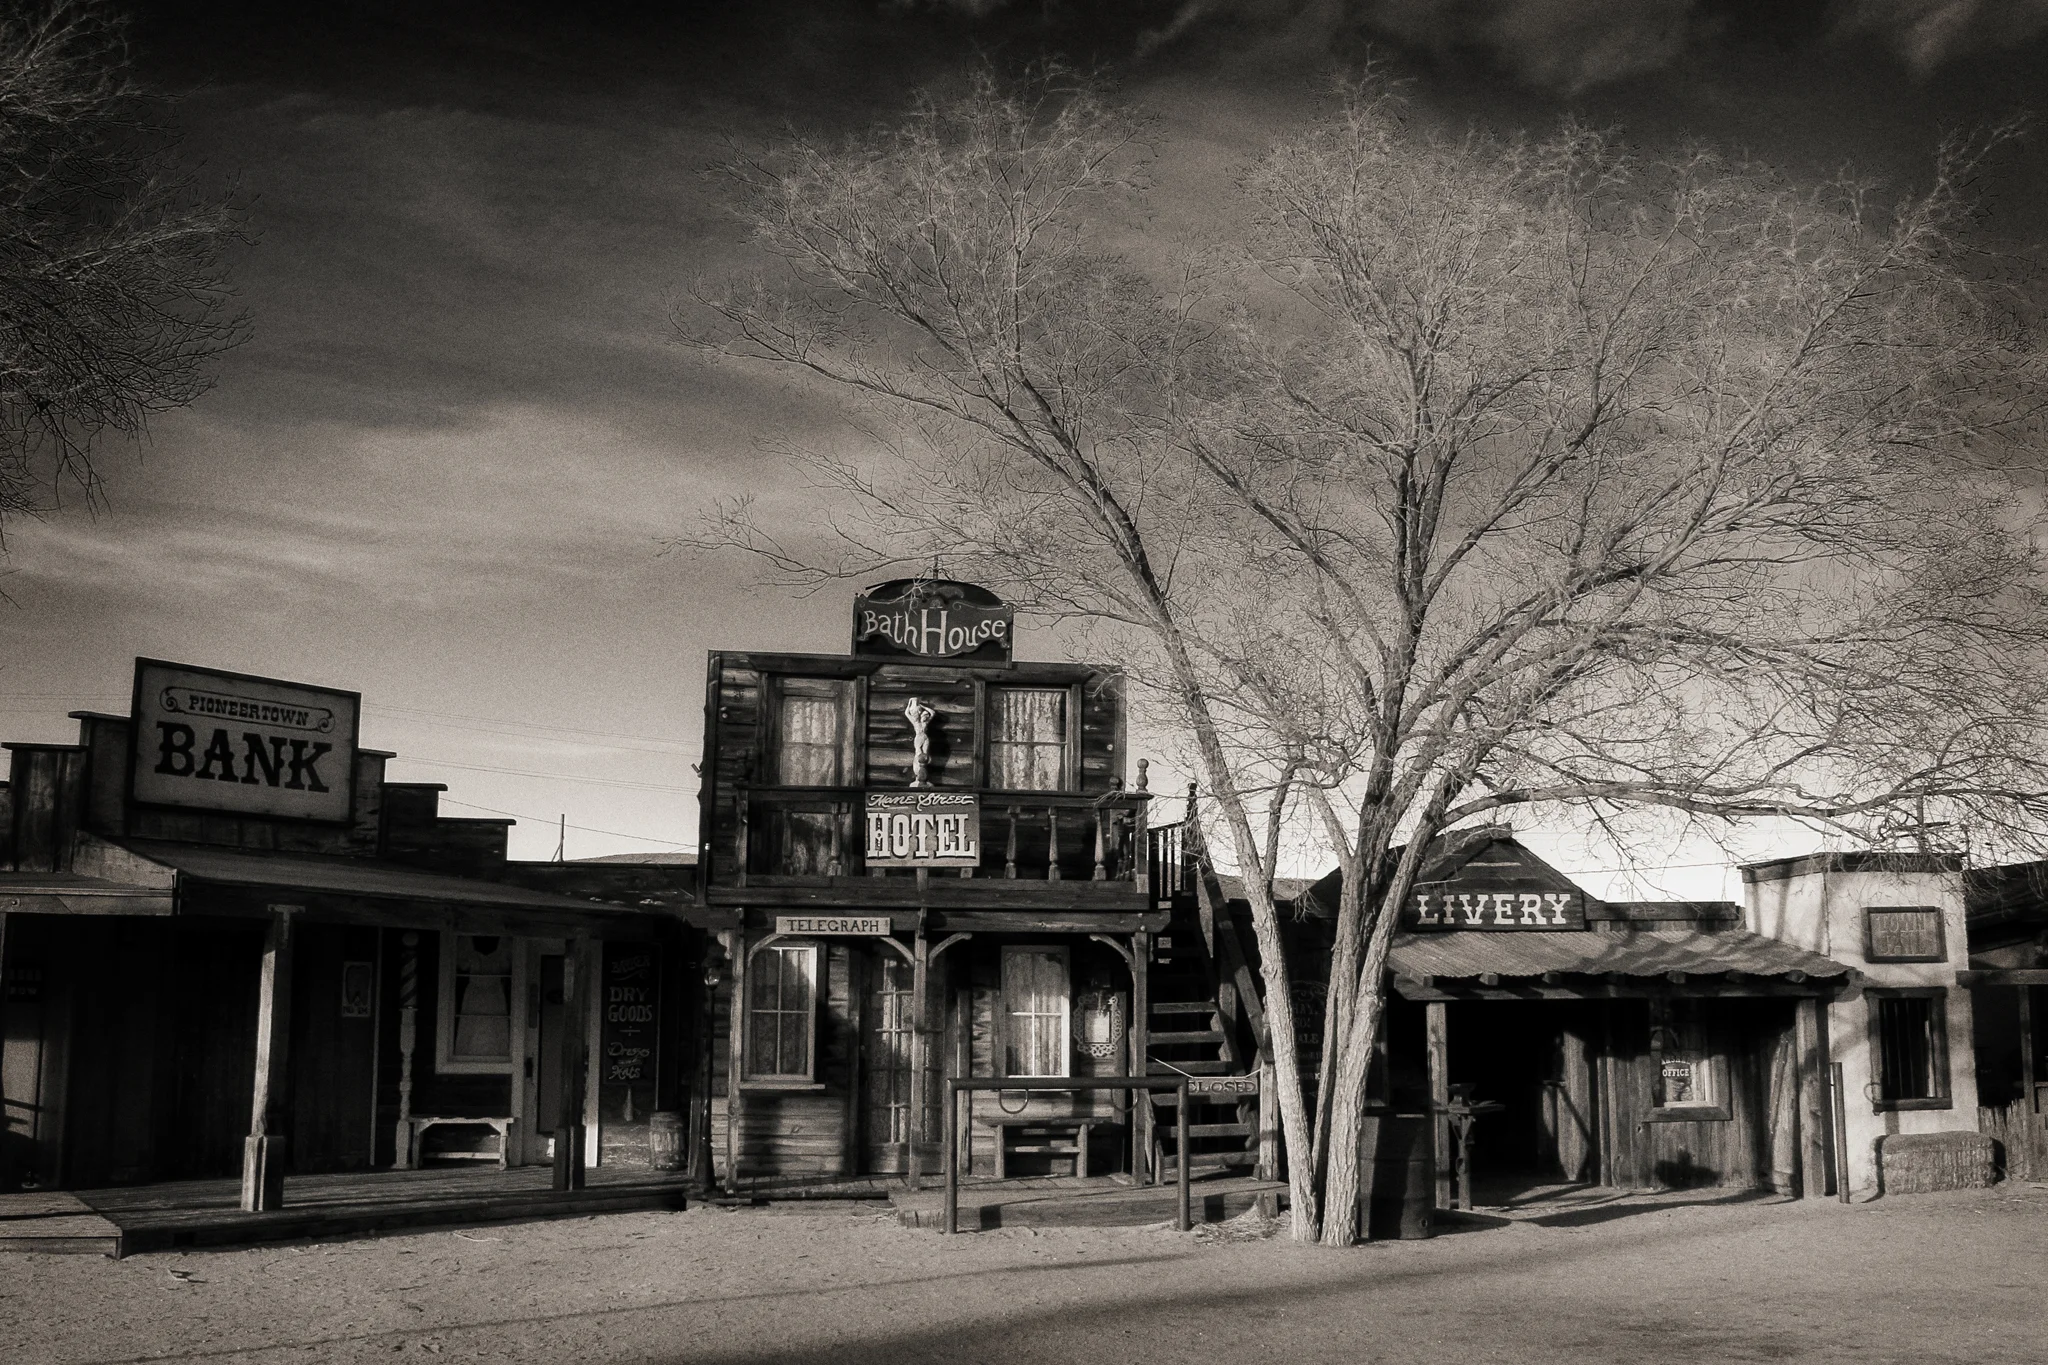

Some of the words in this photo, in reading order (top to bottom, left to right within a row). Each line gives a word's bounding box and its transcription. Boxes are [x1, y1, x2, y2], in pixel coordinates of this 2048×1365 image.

[188, 694, 309, 727] PIONEERTOWN
[154, 721, 333, 794] BANK
[917, 792, 975, 811] Street
[867, 812, 977, 859] HOTEL
[1416, 893, 1571, 925] LIVERY
[786, 919, 880, 932] TELEGRAPH
[608, 985, 650, 1003] DRY
[607, 1003, 653, 1023] GOODS
[1662, 1068, 1690, 1078] OFFICE
